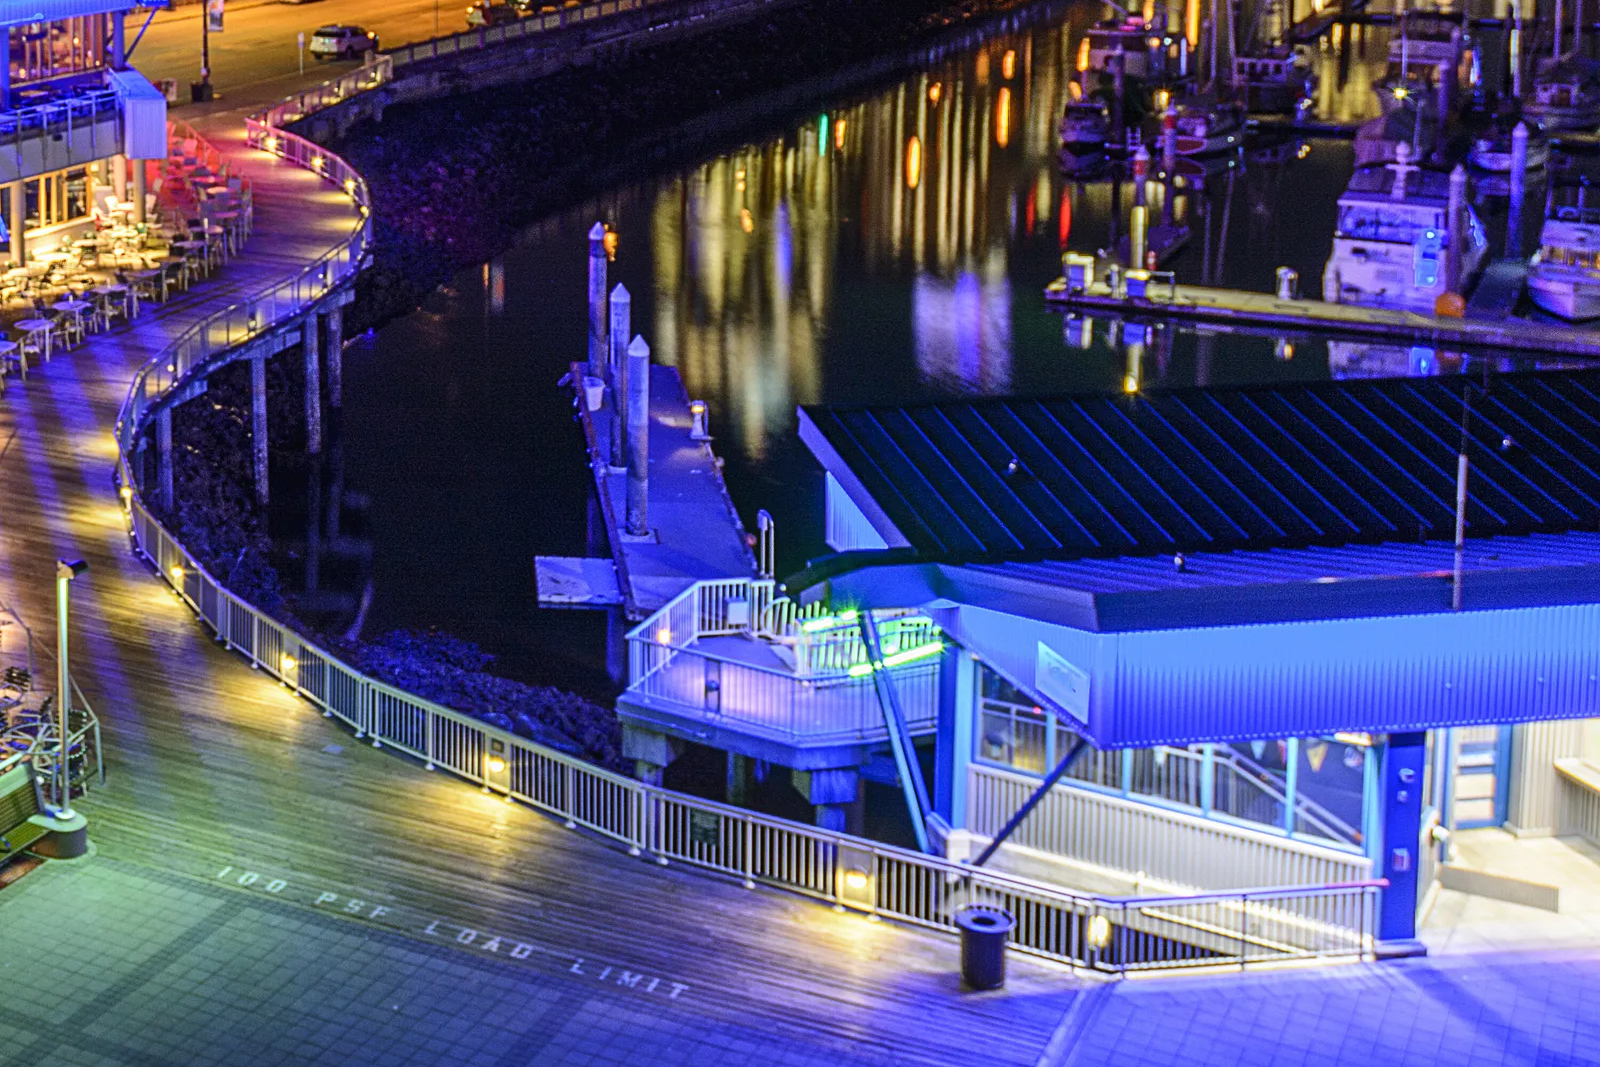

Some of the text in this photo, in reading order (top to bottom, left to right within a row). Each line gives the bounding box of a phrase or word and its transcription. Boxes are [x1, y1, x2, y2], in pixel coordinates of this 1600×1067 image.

[217, 865, 690, 1000] 100 PSF LOAD LIMIT
